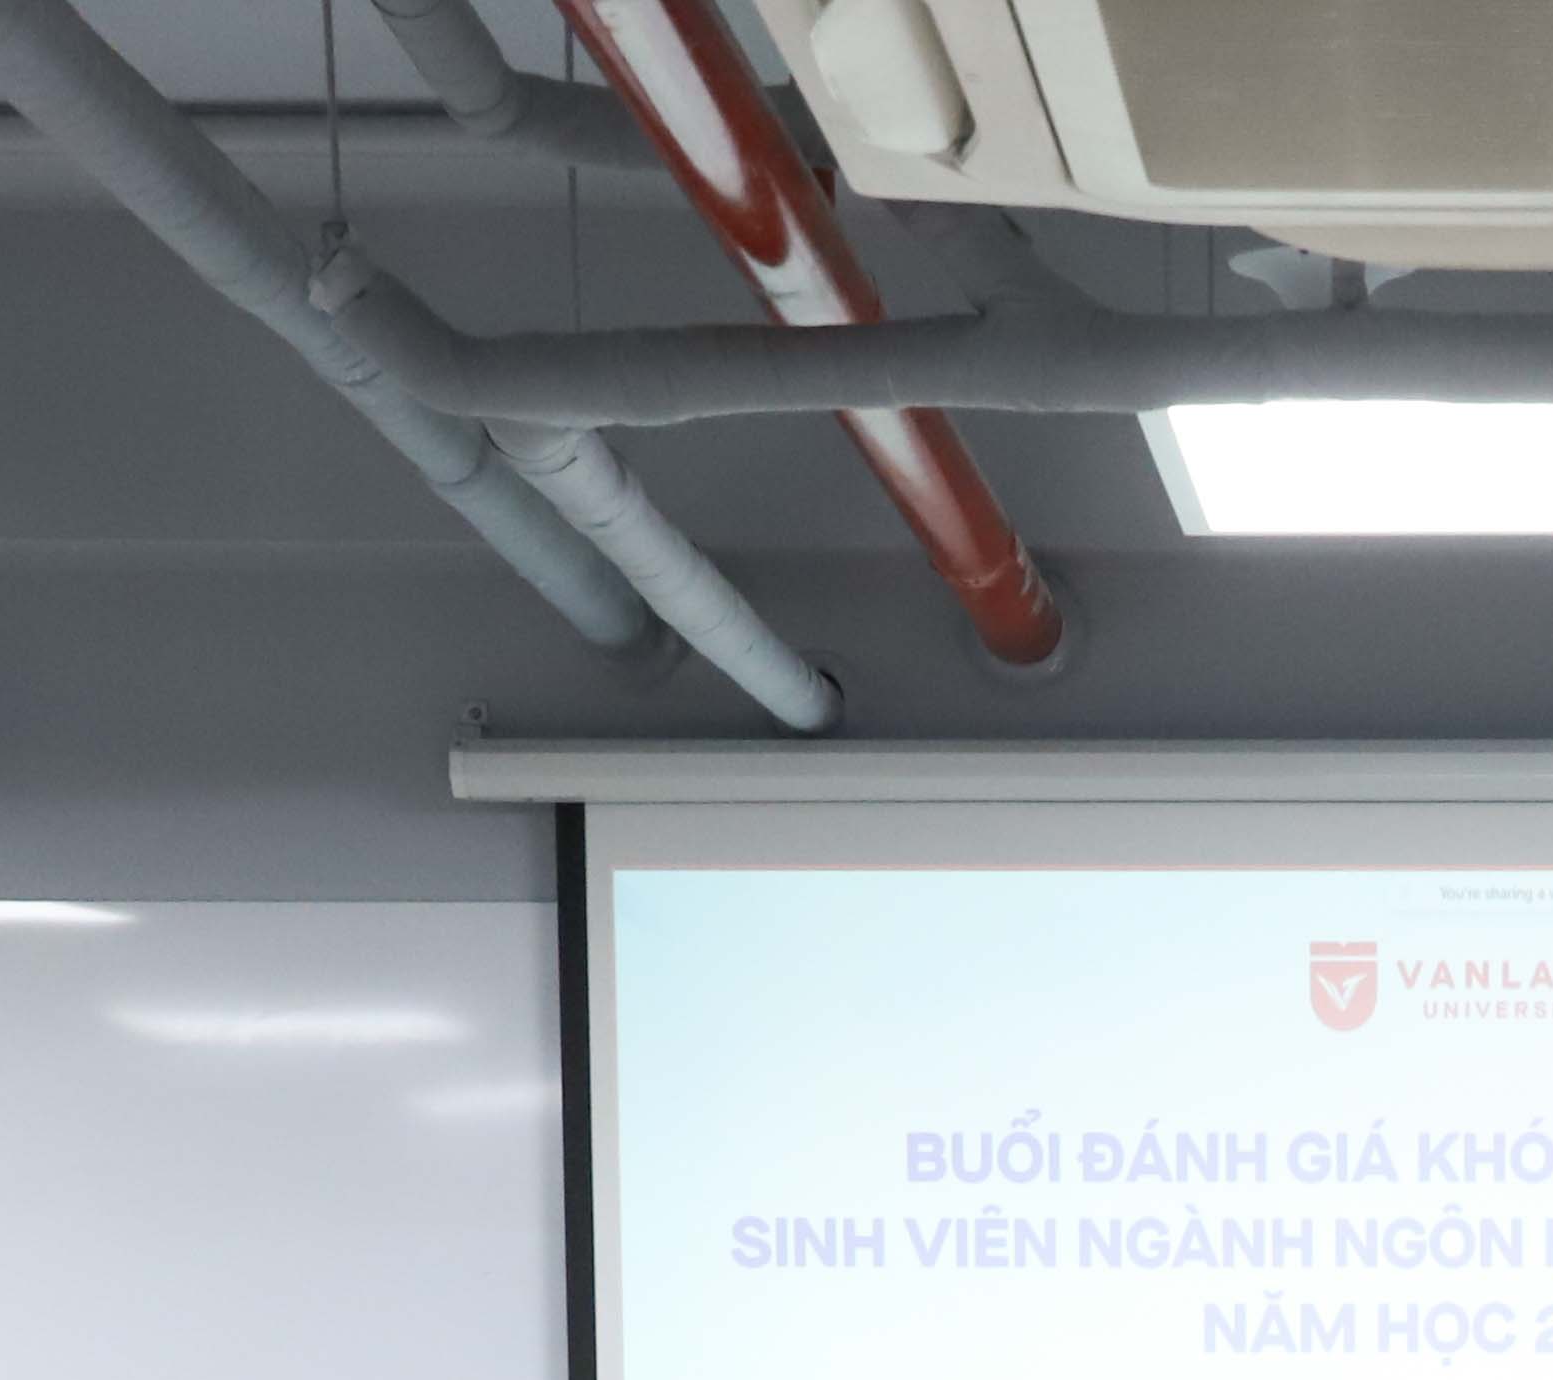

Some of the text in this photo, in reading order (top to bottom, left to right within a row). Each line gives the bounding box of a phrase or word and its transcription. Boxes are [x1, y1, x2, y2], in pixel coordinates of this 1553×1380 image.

[1486, 884, 1534, 903] sharing
[906, 1108, 1060, 1183] BUỔI
[1078, 1118, 1267, 1183] ĐÁNH
[1287, 1118, 1399, 1184] GIÁ
[731, 1216, 885, 1269] SINH
[904, 1205, 1056, 1269] VIÊN
[1078, 1205, 1313, 1269] NGÀNH
[1334, 1205, 1522, 1268] NGÔN
[1204, 1290, 1355, 1353] NĂM
[1378, 1302, 1515, 1366] HỌC
